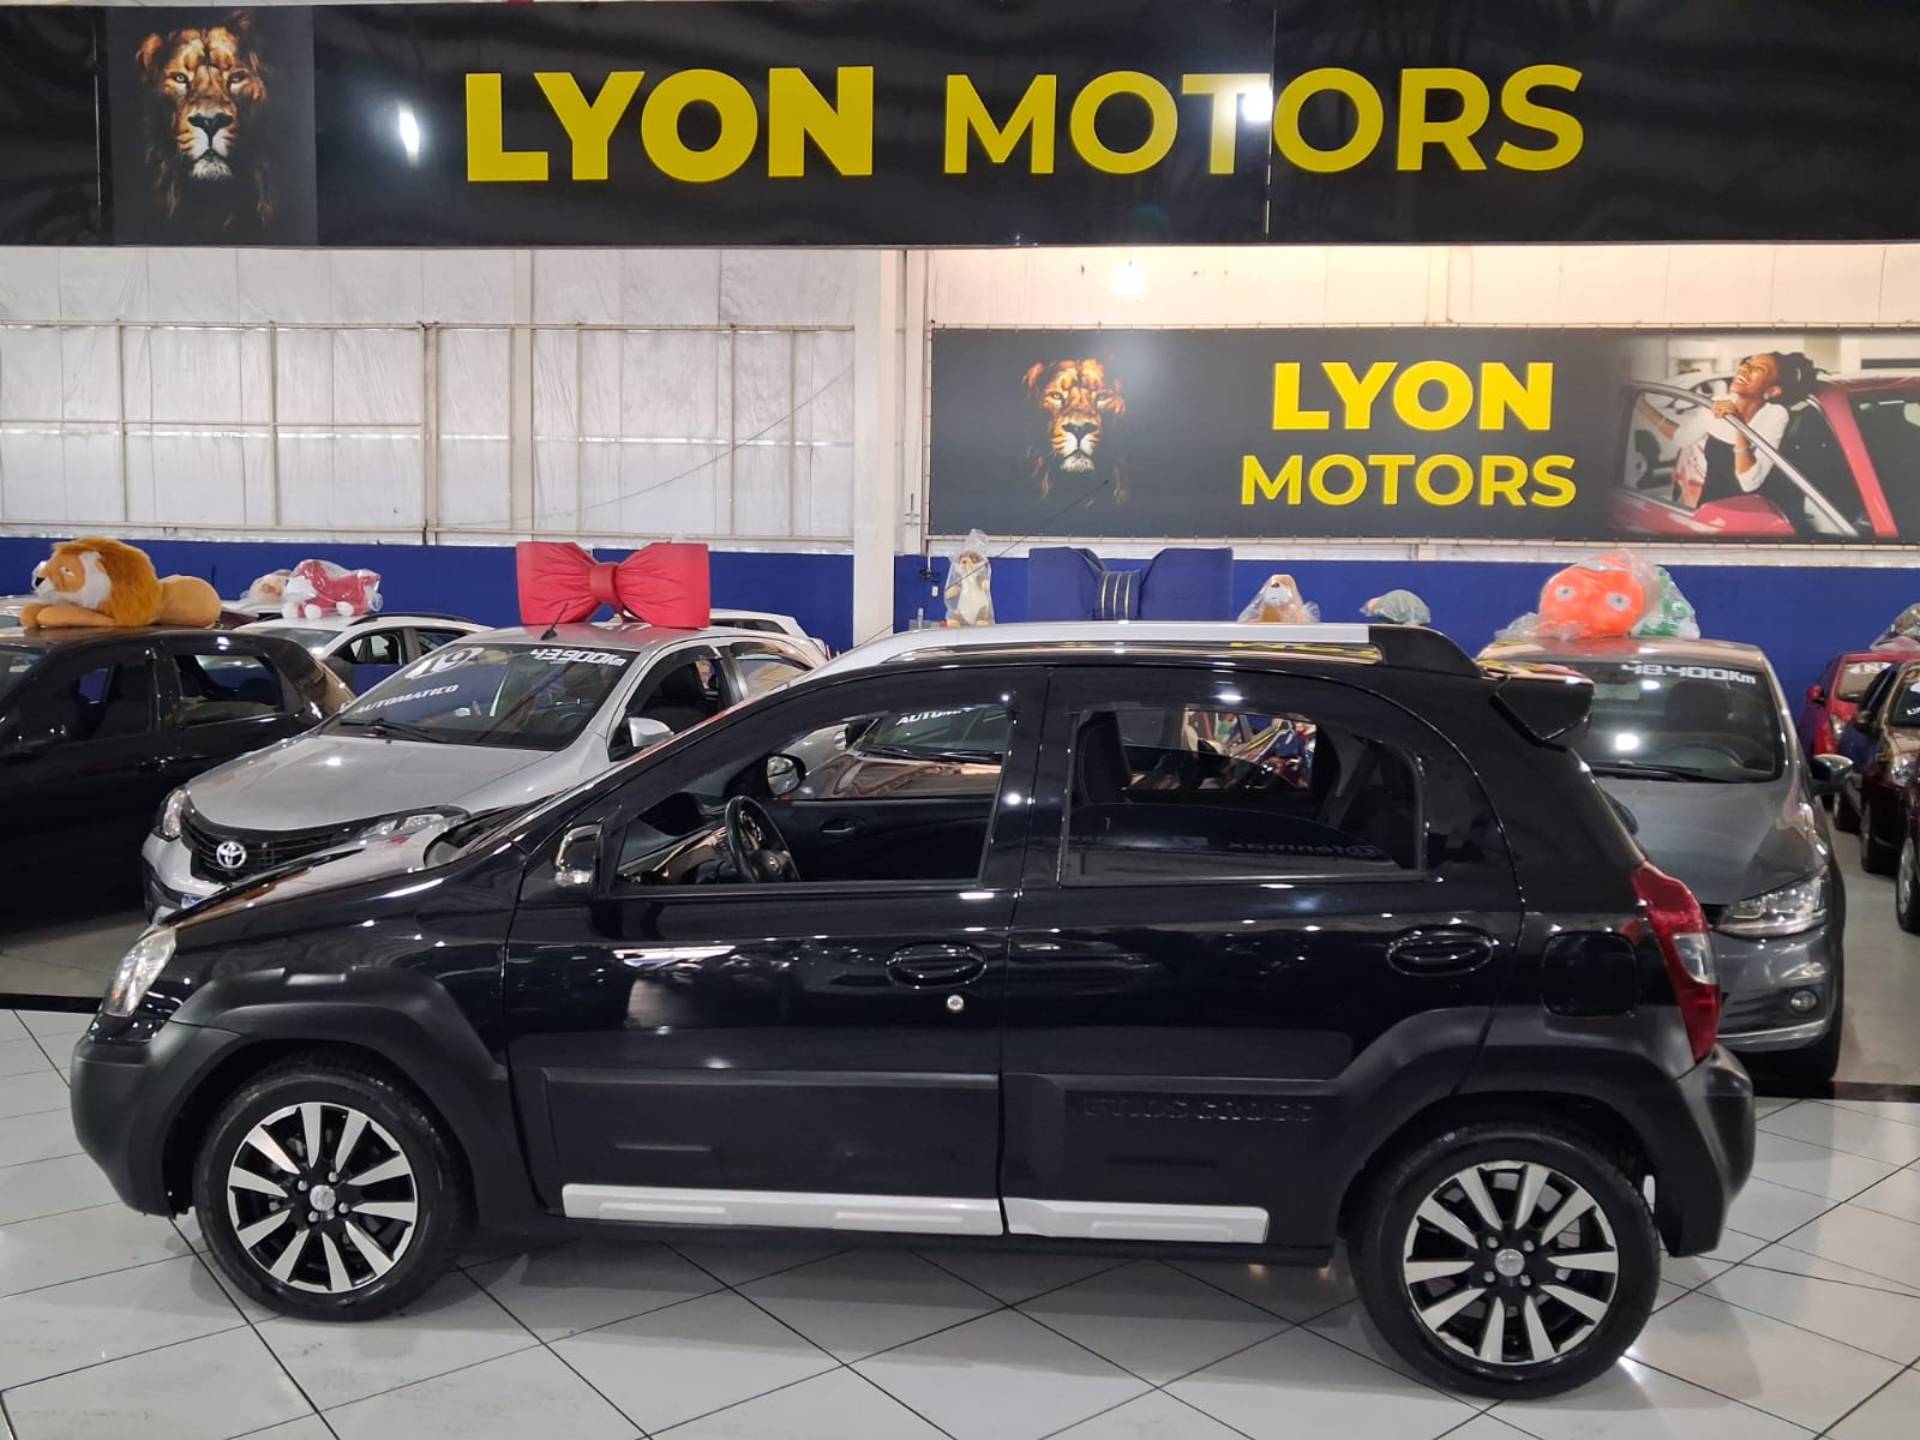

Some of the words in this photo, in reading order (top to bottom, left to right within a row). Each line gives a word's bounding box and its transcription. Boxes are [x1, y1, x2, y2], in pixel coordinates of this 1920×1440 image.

[465, 65, 874, 183] LYON
[944, 64, 1583, 174] MOTORS
[1270, 359, 1556, 432] LYON
[1240, 452, 1576, 509] MOTORS
